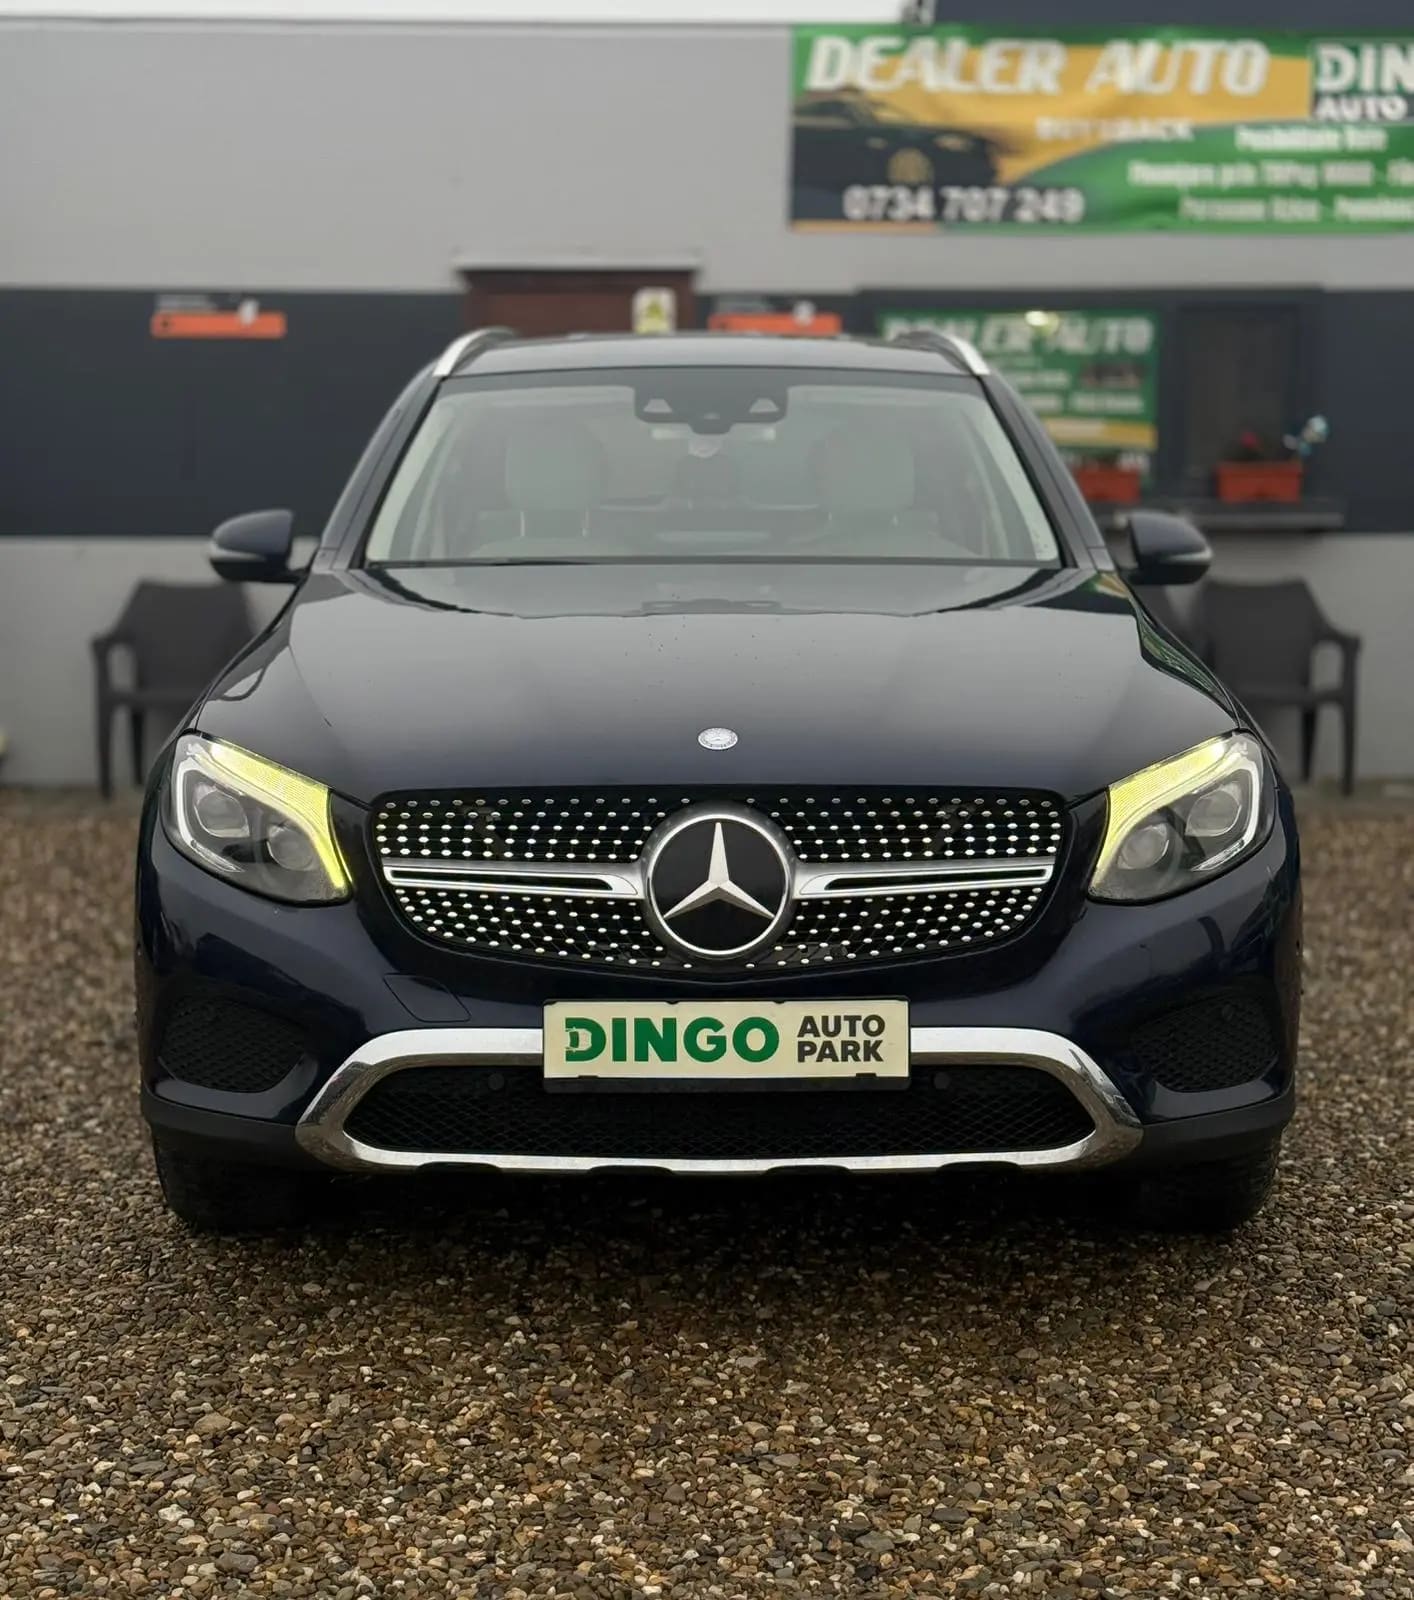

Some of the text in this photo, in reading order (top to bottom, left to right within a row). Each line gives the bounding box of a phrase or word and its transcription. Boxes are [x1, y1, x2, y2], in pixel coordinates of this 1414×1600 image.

[804, 36, 1271, 97] DEALER AUTO
[1314, 95, 1408, 121] AUTO
[843, 186, 935, 221] 0734
[564, 1016, 780, 1063] DINGO
[796, 1014, 886, 1038] AUTO
[796, 1040, 884, 1063] PARK
